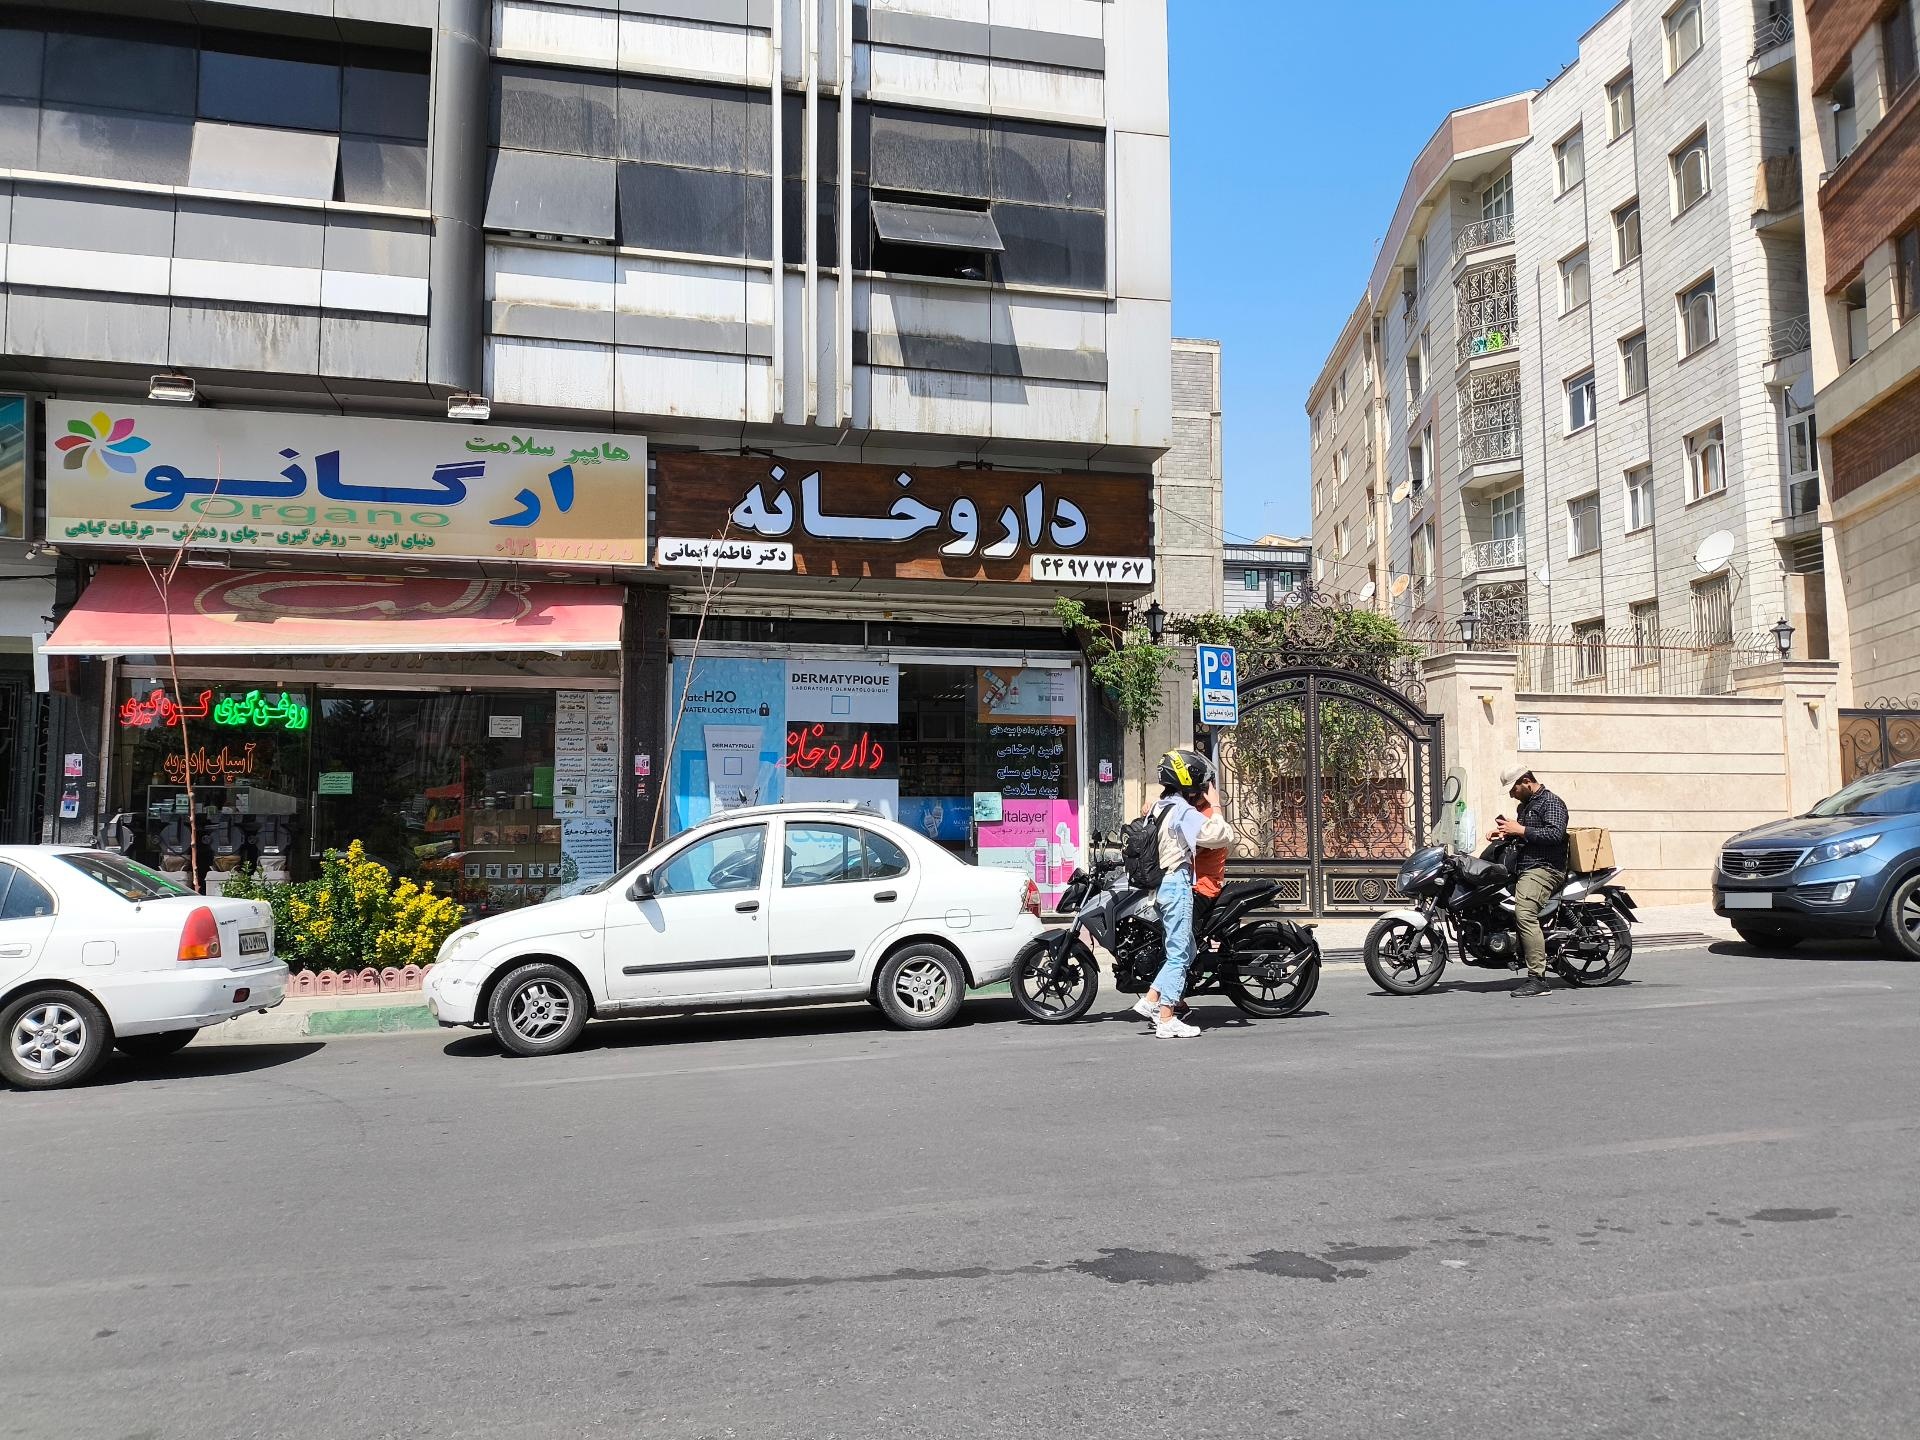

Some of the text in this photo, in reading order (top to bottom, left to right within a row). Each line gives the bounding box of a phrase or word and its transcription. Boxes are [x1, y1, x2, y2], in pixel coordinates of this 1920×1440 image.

[465, 434, 630, 464] هایپر سلامت
[190, 497, 451, 527] Organo
[731, 464, 1088, 559] داروخانه
[64, 519, 107, 538] گیاهی
[108, 520, 154, 540] عرقیات
[230, 525, 260, 544] چای
[276, 527, 310, 546] گیری
[312, 528, 346, 547] روغن
[367, 532, 399, 549] ادویه
[401, 532, 436, 550] دنیای
[664, 543, 787, 566] دکتر فاطمه ایمانی
[1204, 651, 1218, 685] P
[792, 673, 890, 686] DERMATYPIQUE
[119, 689, 212, 726] کره گیری
[213, 690, 310, 729] روغن گیری
[707, 706, 728, 714] LOCK
[729, 707, 757, 715] SYSTEM
[996, 744, 1064, 760] تامین اجتماعی
[163, 743, 256, 784] آسیاب ادویه
[996, 765, 1020, 780] مسلح
[1002, 783, 1059, 800] بیمه سلامت
[1744, 860, 1756, 868] KIA
